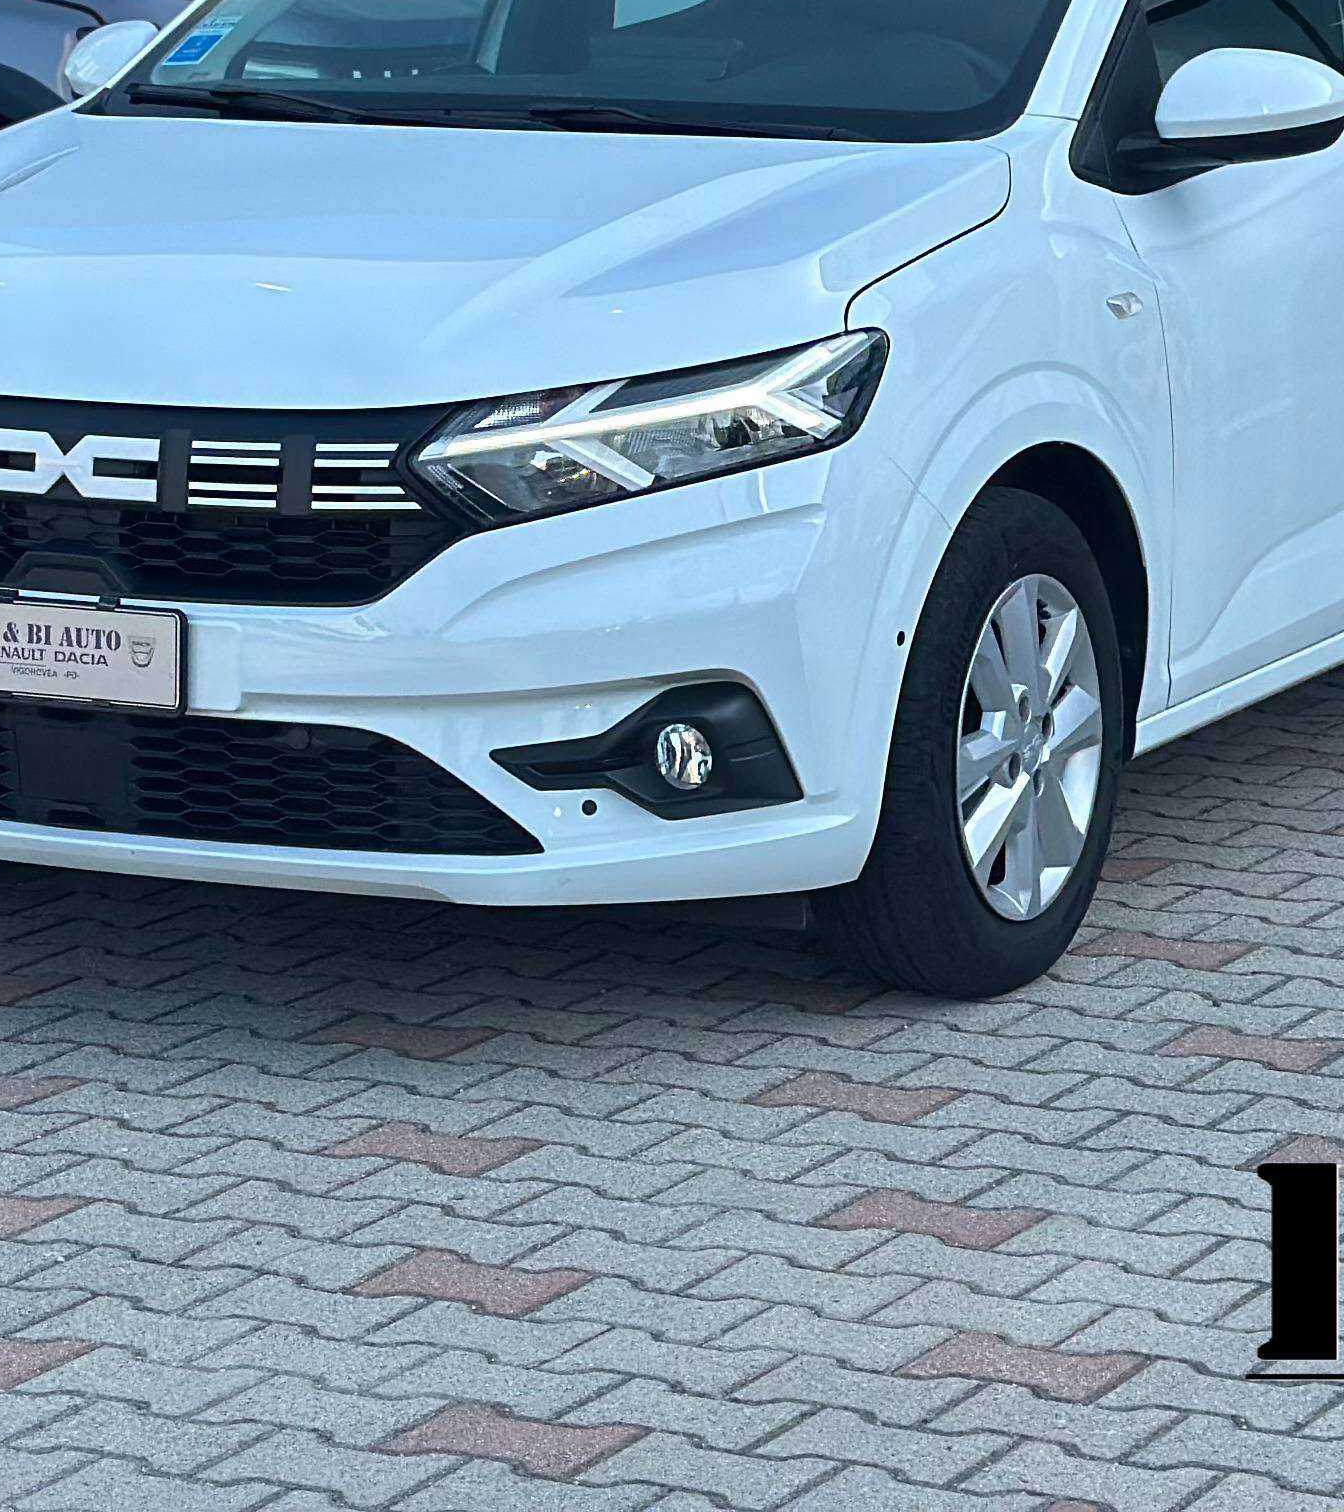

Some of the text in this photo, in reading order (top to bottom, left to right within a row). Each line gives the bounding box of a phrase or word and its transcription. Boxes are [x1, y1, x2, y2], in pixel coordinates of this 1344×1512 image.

[3, 621, 19, 643] &
[27, 623, 52, 645] BI
[59, 626, 122, 651] AUTO
[55, 650, 108, 667] DACIA
